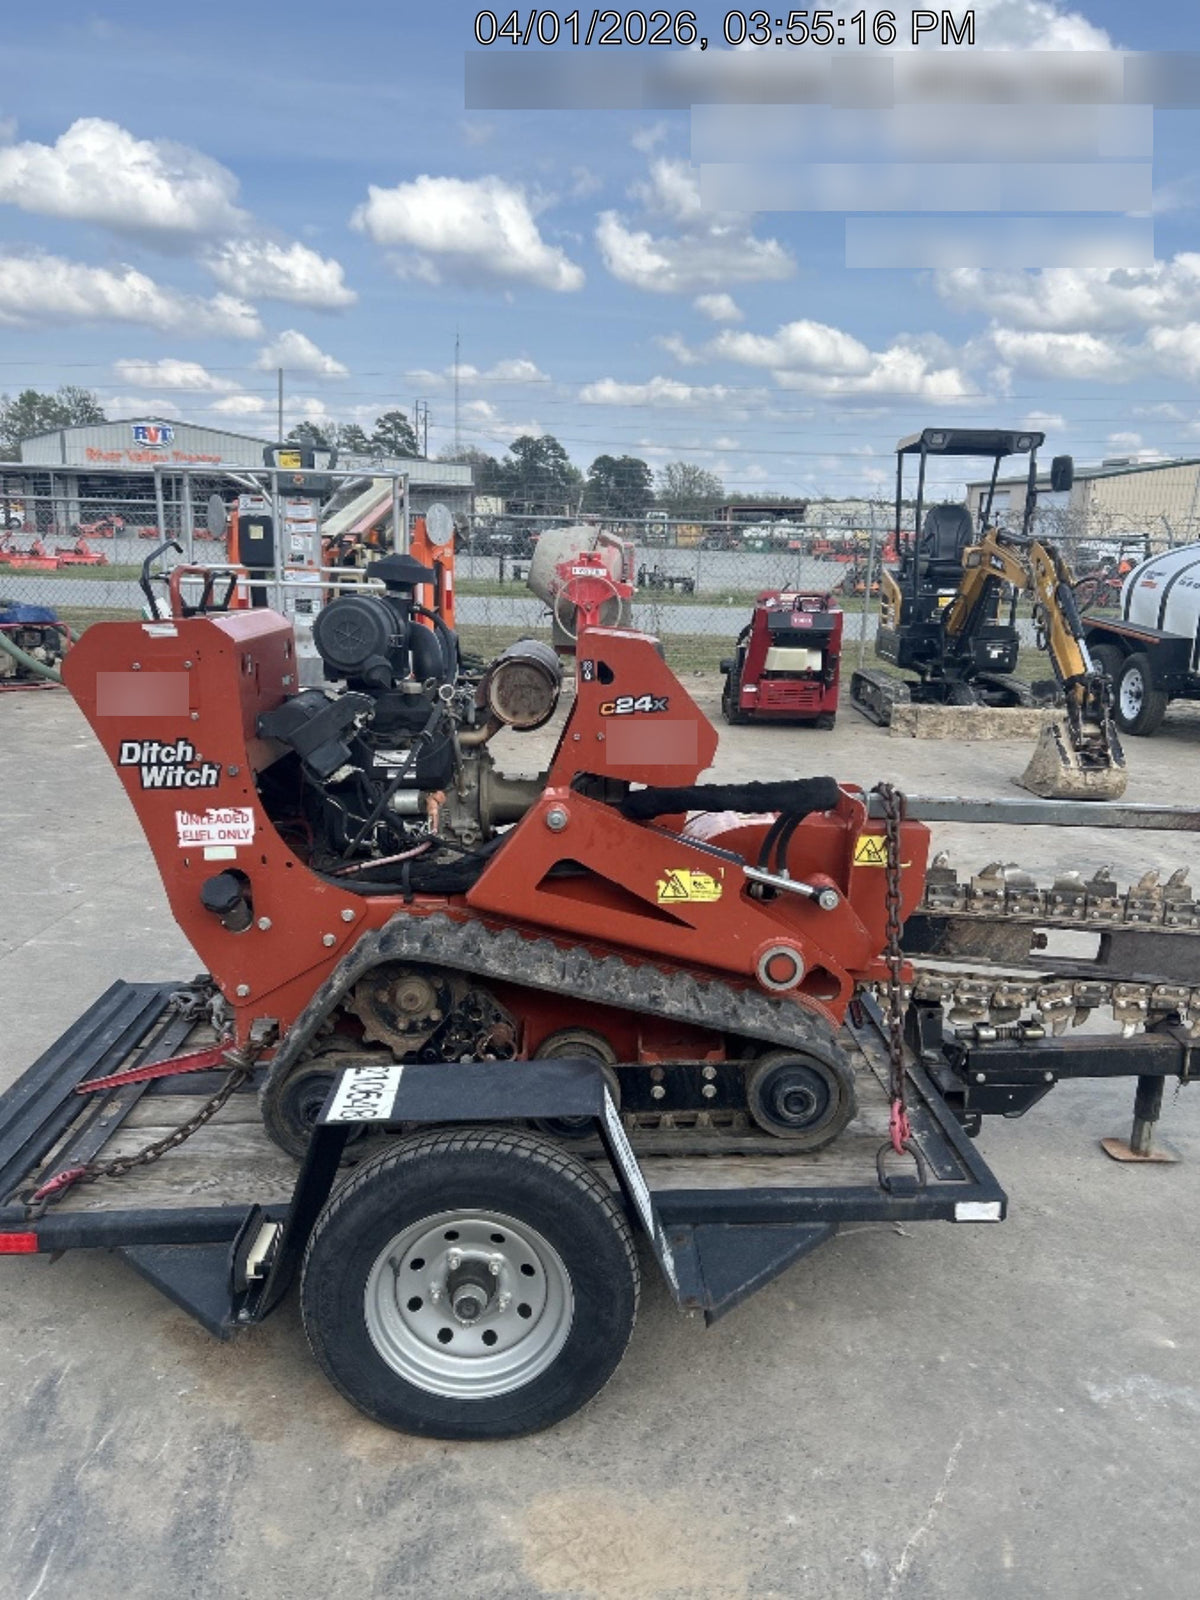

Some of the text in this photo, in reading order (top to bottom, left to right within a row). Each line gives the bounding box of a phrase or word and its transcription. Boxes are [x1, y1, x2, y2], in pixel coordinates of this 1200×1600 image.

[133, 425, 172, 444] RVT
[120, 740, 194, 764] Ditch
[141, 763, 218, 788] Witch
[180, 812, 250, 826] UNLEADED
[218, 829, 251, 840] ONLY
